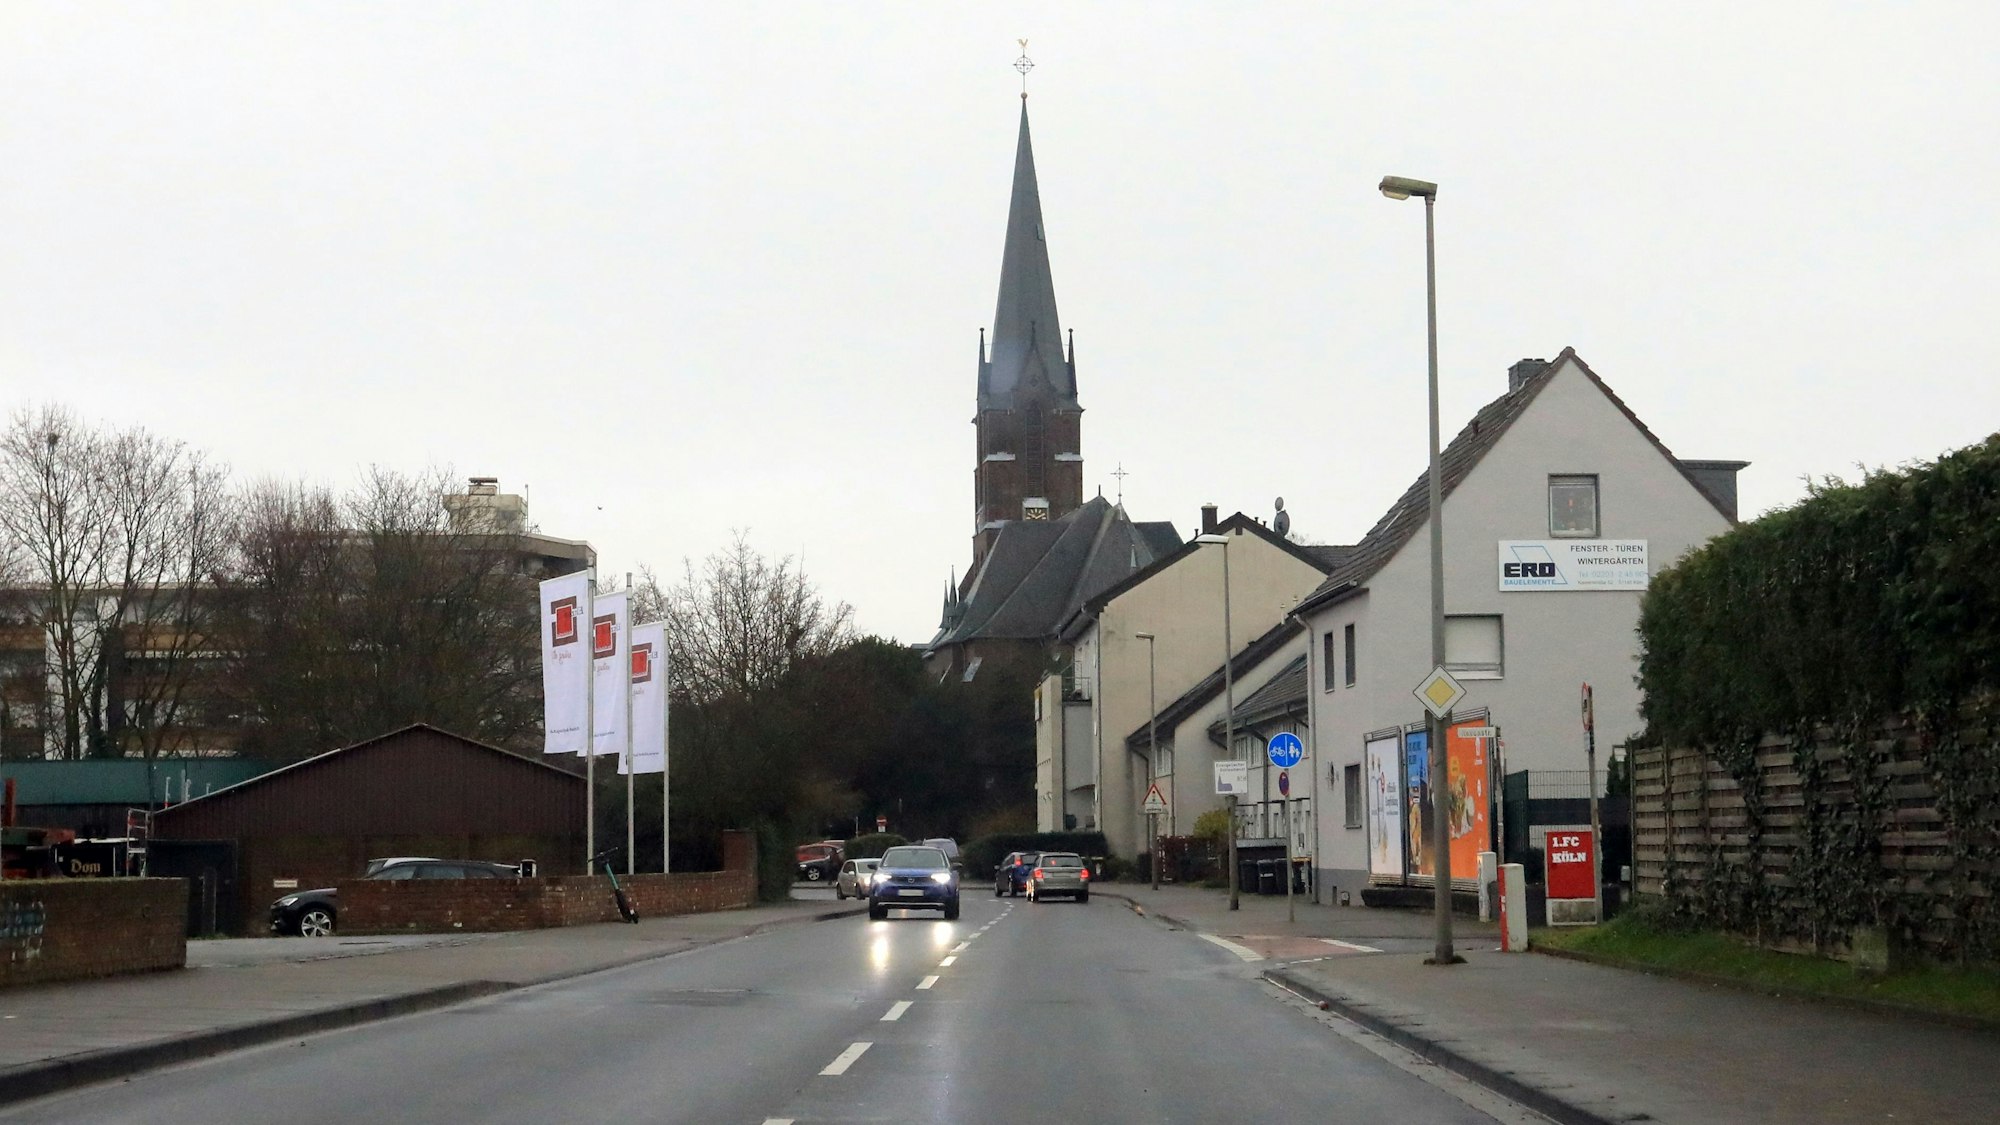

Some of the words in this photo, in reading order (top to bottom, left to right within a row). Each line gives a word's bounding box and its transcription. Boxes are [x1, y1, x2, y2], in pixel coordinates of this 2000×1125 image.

[1570, 544, 1608, 552] FENSTER
[1615, 544, 1643, 552] TÜREN
[1577, 556, 1644, 565] WINTERGÄRTEN
[1504, 562, 1556, 578] ERD
[1552, 836, 1580, 847] 1.FC
[1551, 850, 1587, 863] KÖLN
[70, 858, 101, 873] Dom
